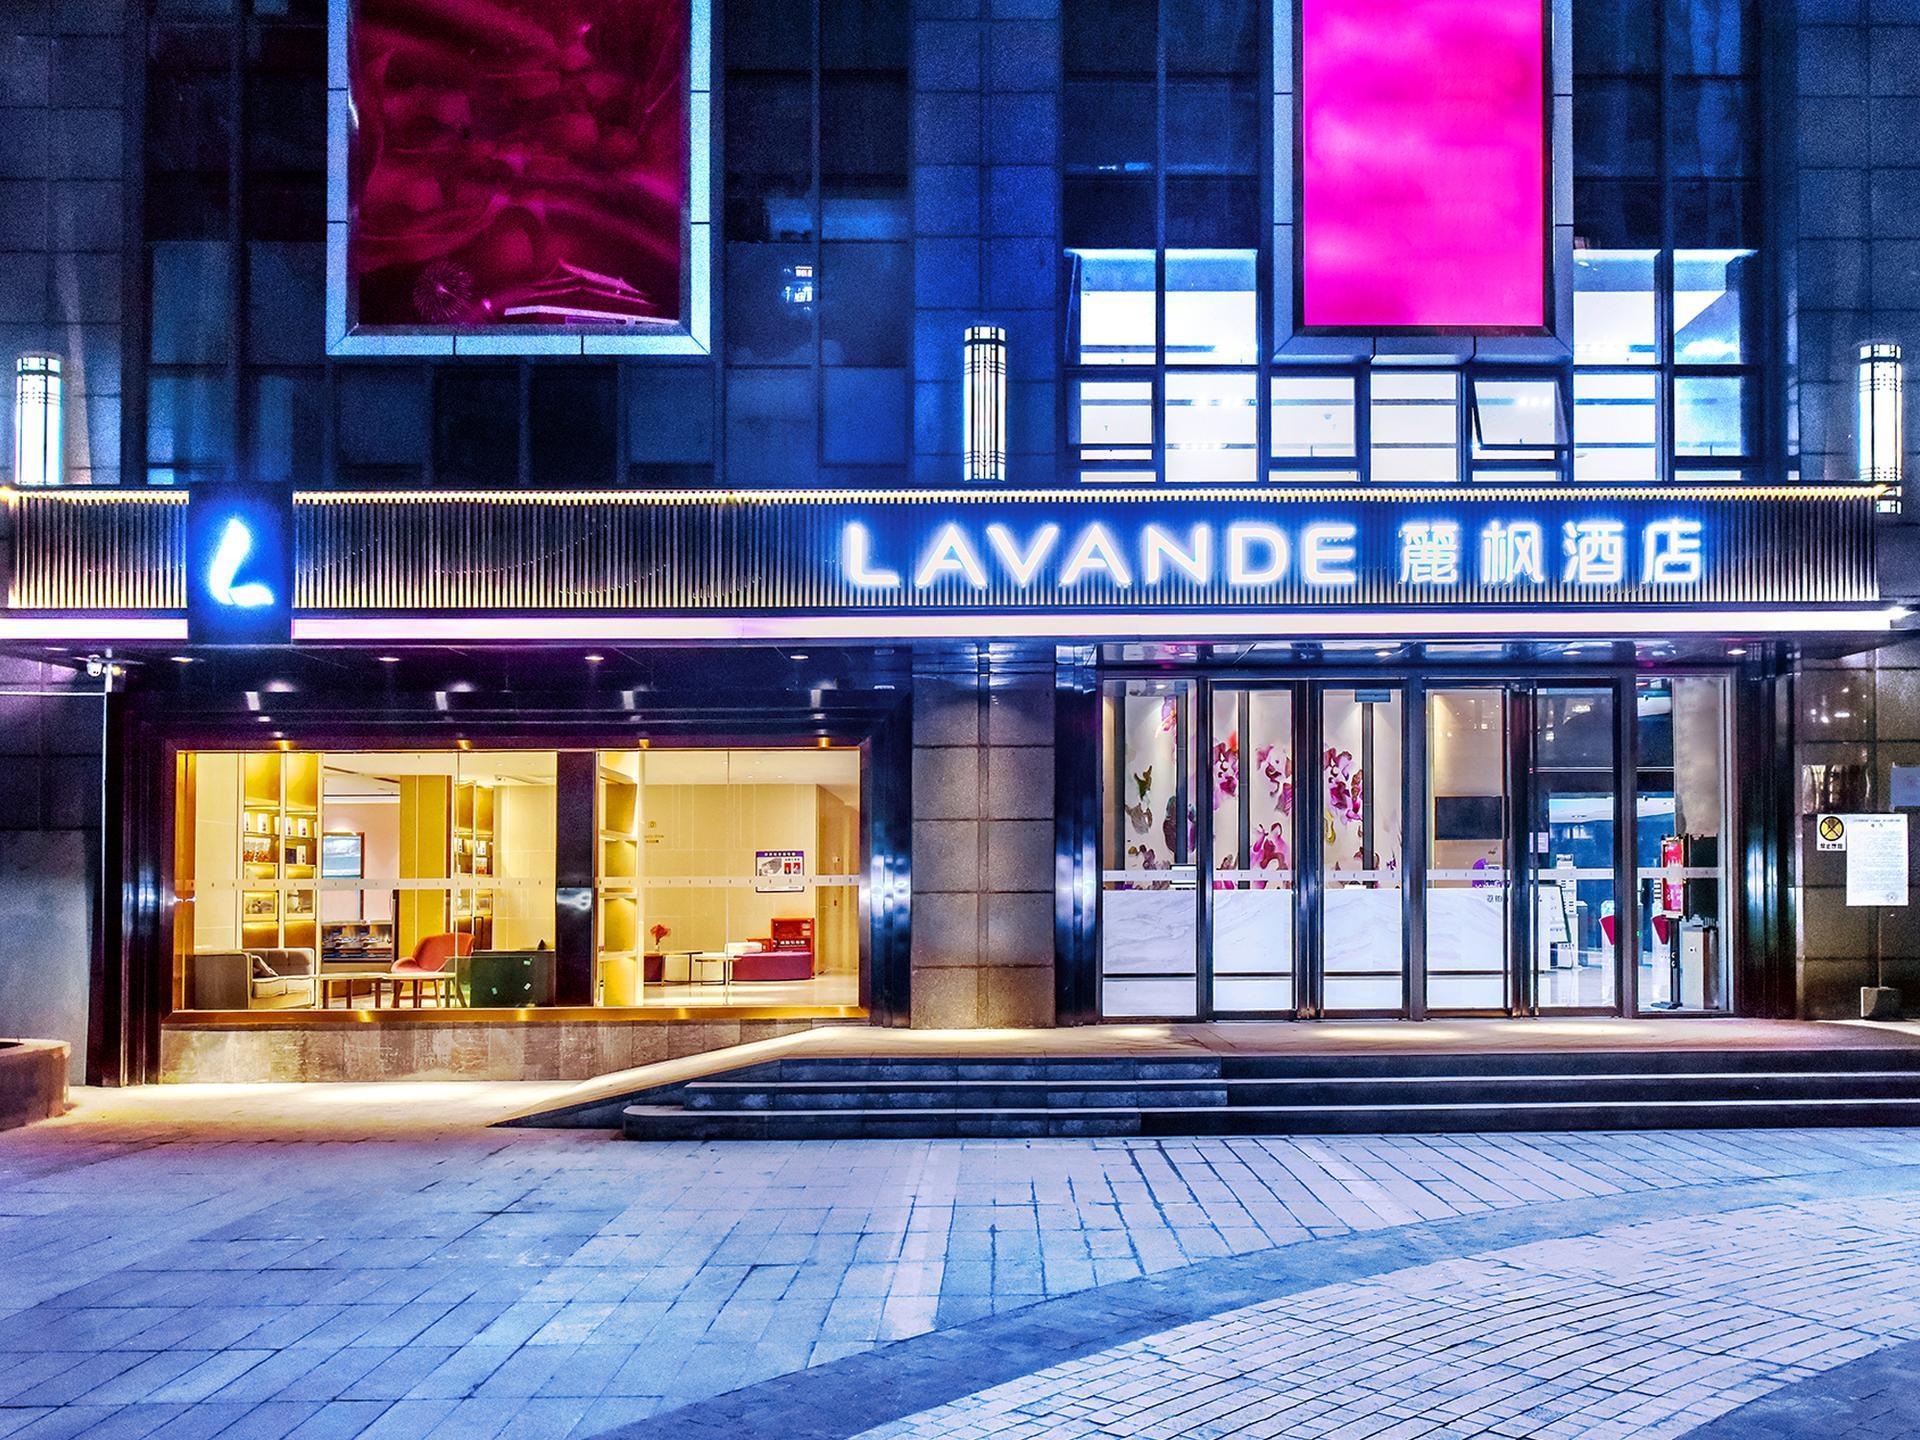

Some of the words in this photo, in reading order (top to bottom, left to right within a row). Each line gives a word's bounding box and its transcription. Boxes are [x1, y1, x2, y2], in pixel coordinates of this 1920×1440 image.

[847, 524, 1357, 588] LAVANDE
[1399, 519, 1703, 584] 麗枫酒店
